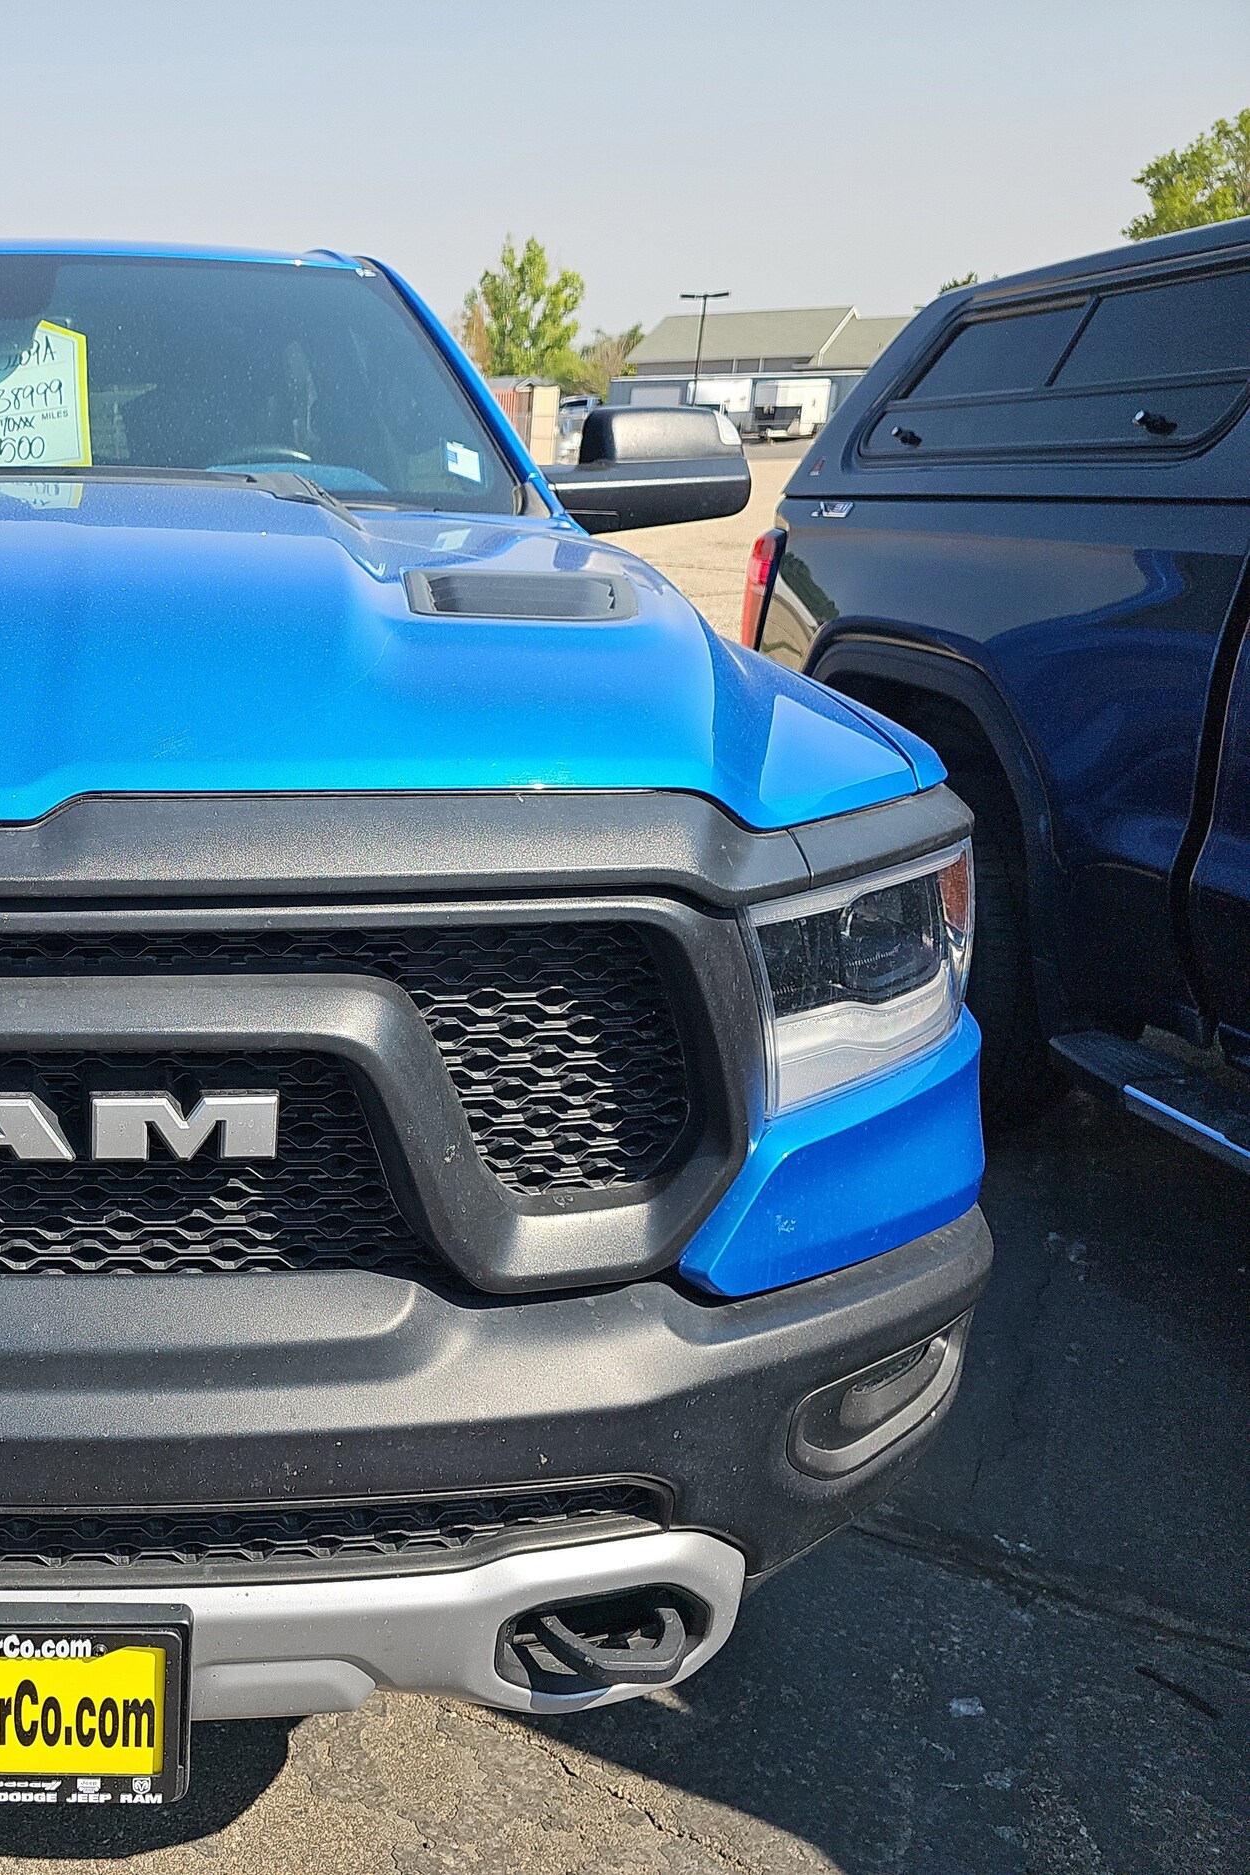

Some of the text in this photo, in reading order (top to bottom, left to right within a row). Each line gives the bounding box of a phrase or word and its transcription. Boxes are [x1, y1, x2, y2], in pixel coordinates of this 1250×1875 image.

[41, 411, 68, 420] MILES
[66, 1793, 112, 1803] JEEP
[120, 1793, 163, 1804] RAM
